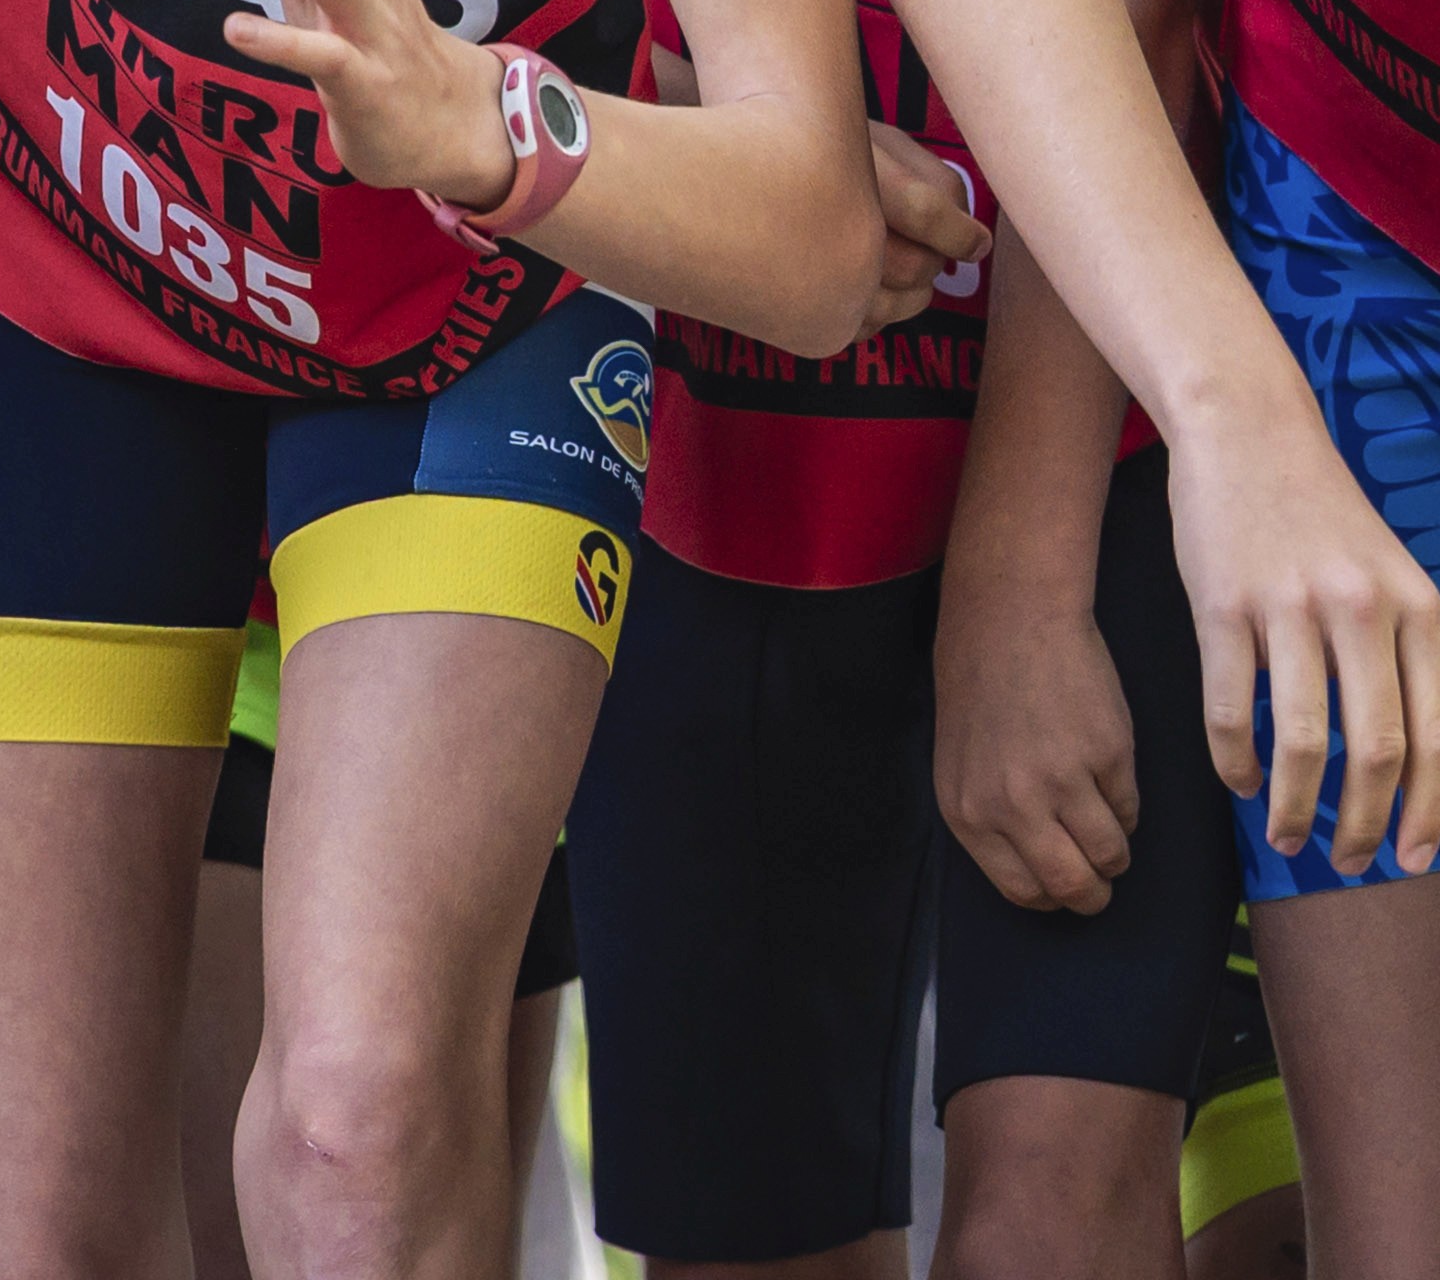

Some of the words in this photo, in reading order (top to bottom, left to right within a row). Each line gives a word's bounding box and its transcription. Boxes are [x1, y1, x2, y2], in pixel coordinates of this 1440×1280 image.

[44, 84, 322, 346] 1035
[161, 292, 368, 398] FRANCE
[508, 429, 595, 464] SALON
[600, 454, 622, 478] DE
